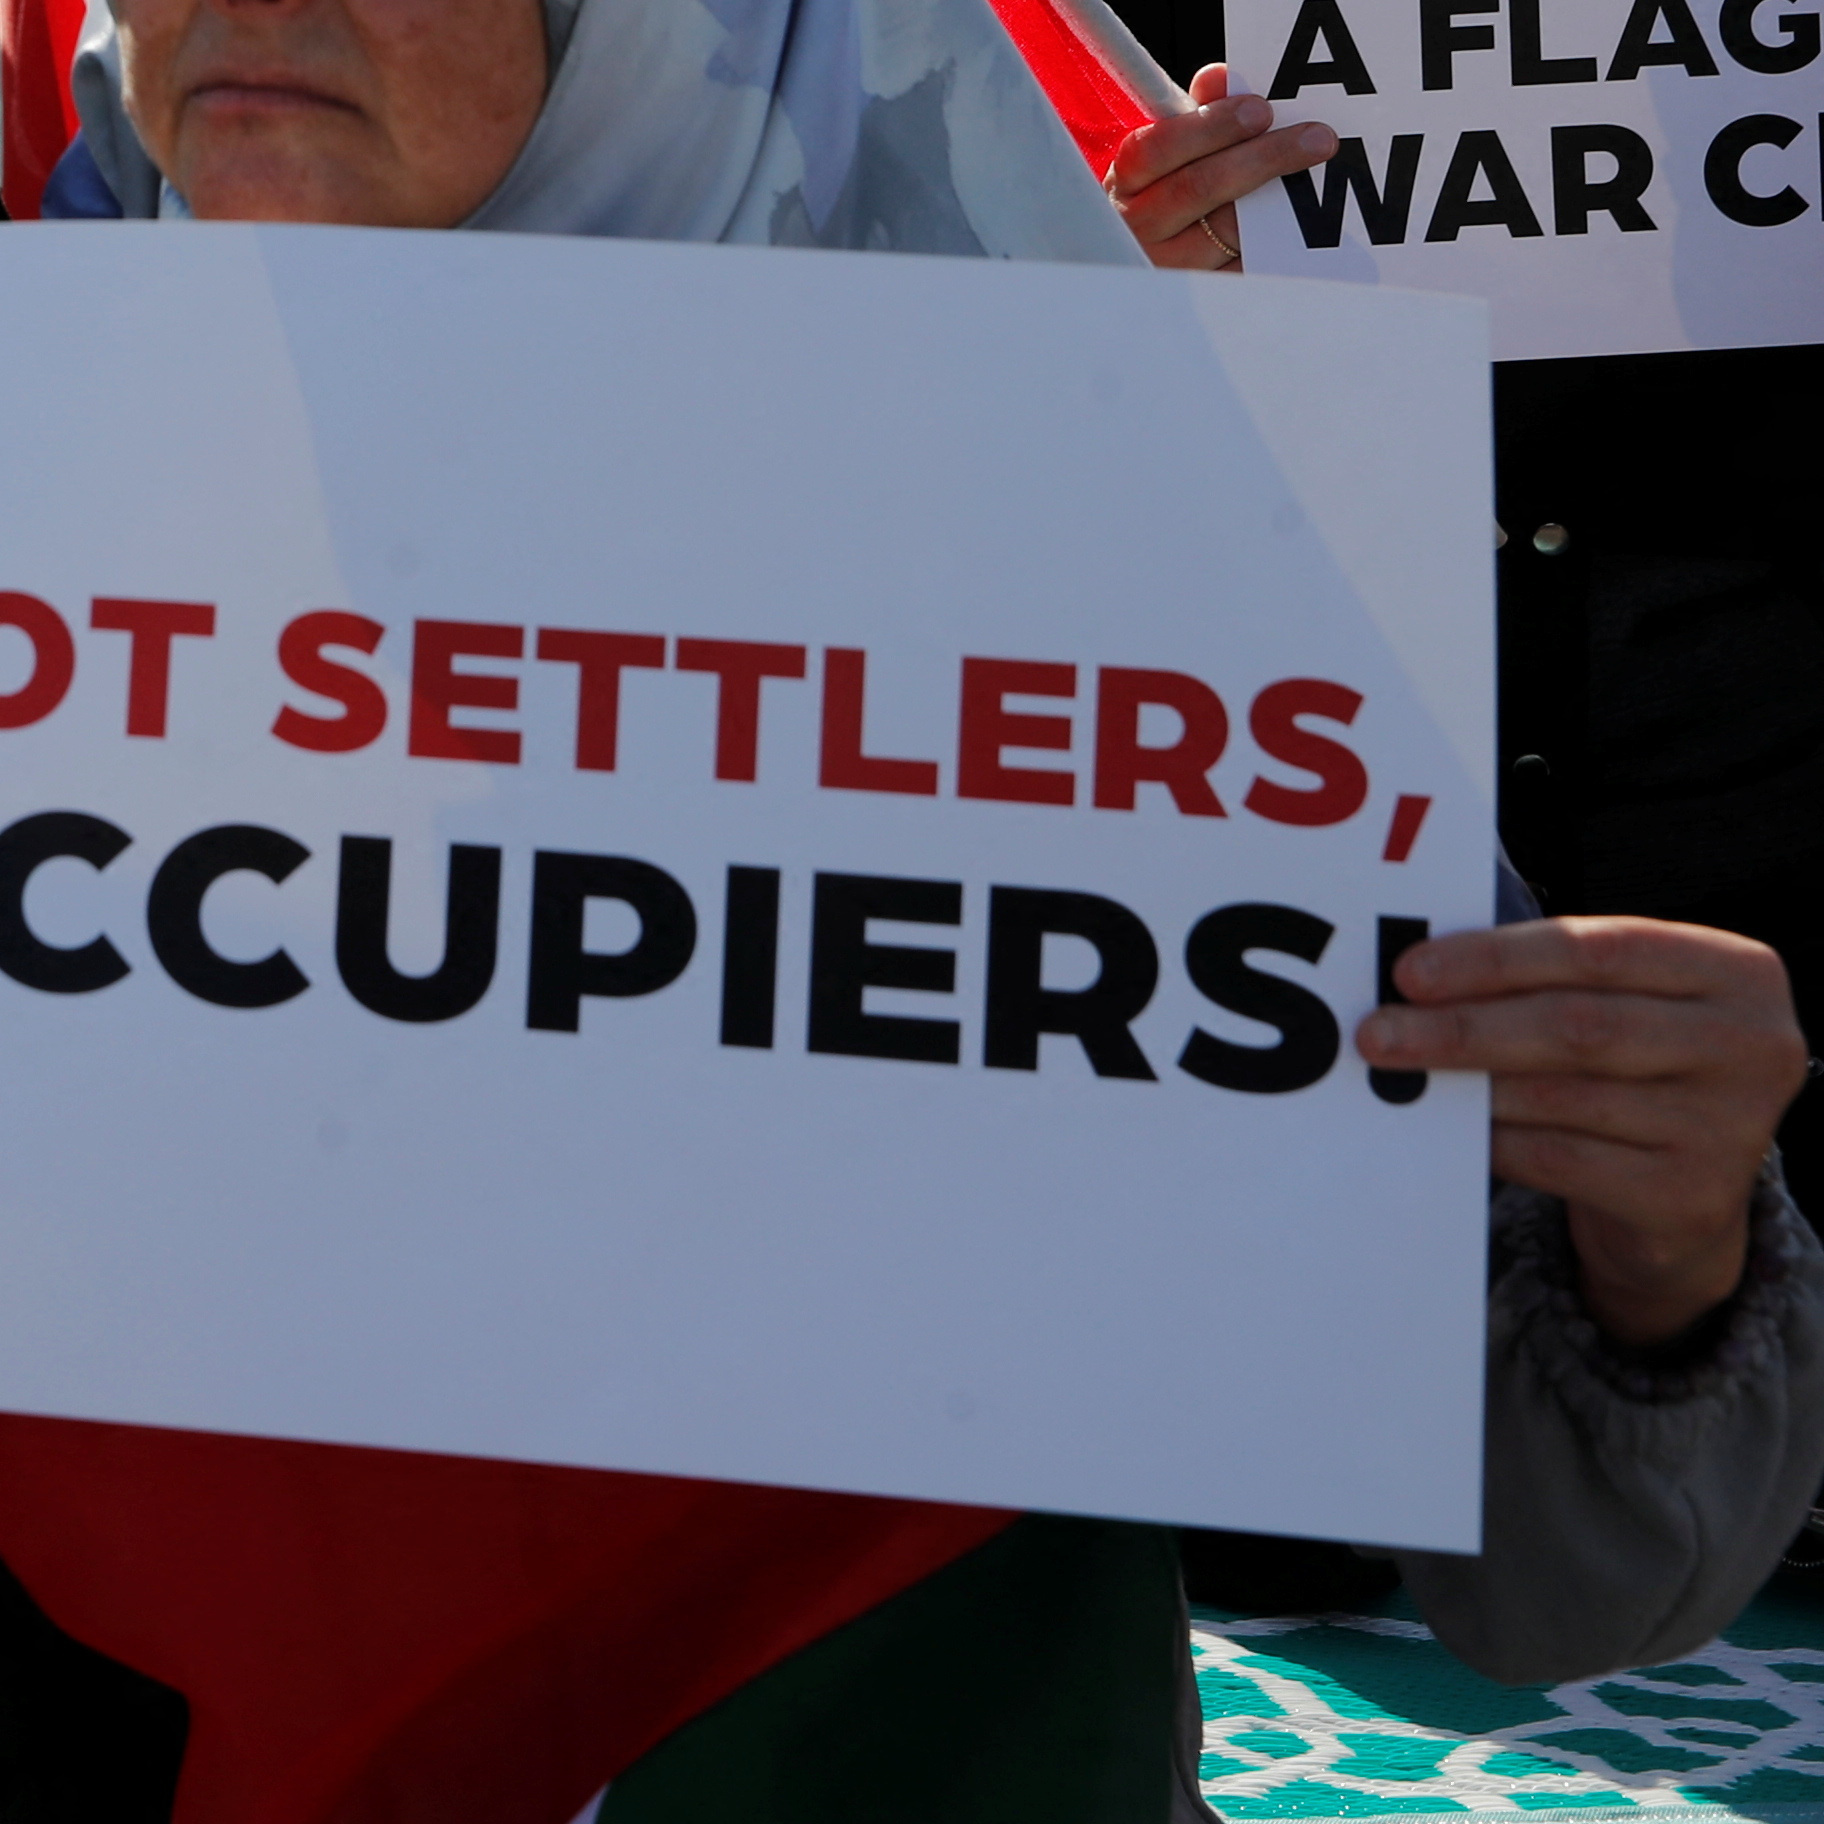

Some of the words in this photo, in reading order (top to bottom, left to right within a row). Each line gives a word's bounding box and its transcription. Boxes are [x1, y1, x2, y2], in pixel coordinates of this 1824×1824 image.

[1280, 123, 1658, 250] WAR
[1703, 113, 1824, 228] C
[270, 608, 1432, 863] SETTLERS,
